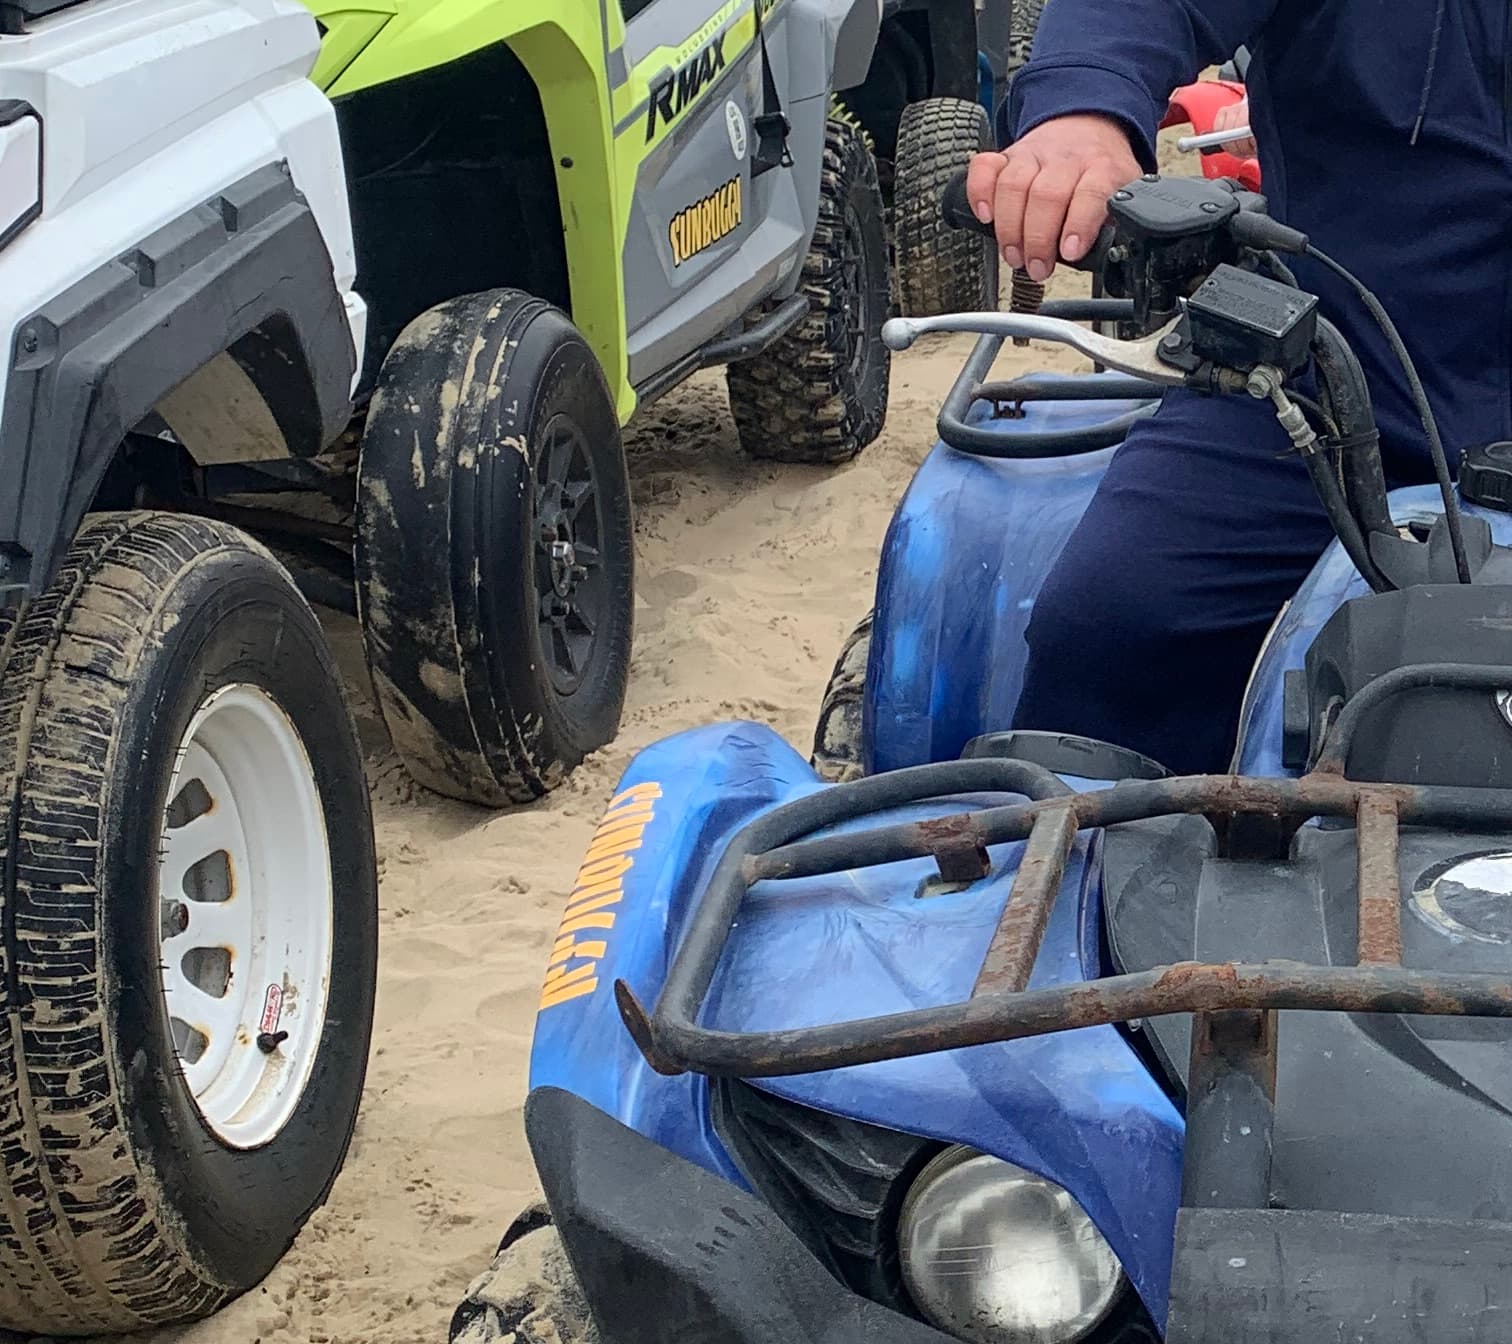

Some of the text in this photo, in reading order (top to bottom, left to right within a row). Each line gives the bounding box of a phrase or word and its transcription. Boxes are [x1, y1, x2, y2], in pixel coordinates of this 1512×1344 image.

[644, 27, 727, 146] RMAX
[669, 173, 742, 269] SUNBUGGY
[538, 781, 664, 1012] SUNBUGGY
